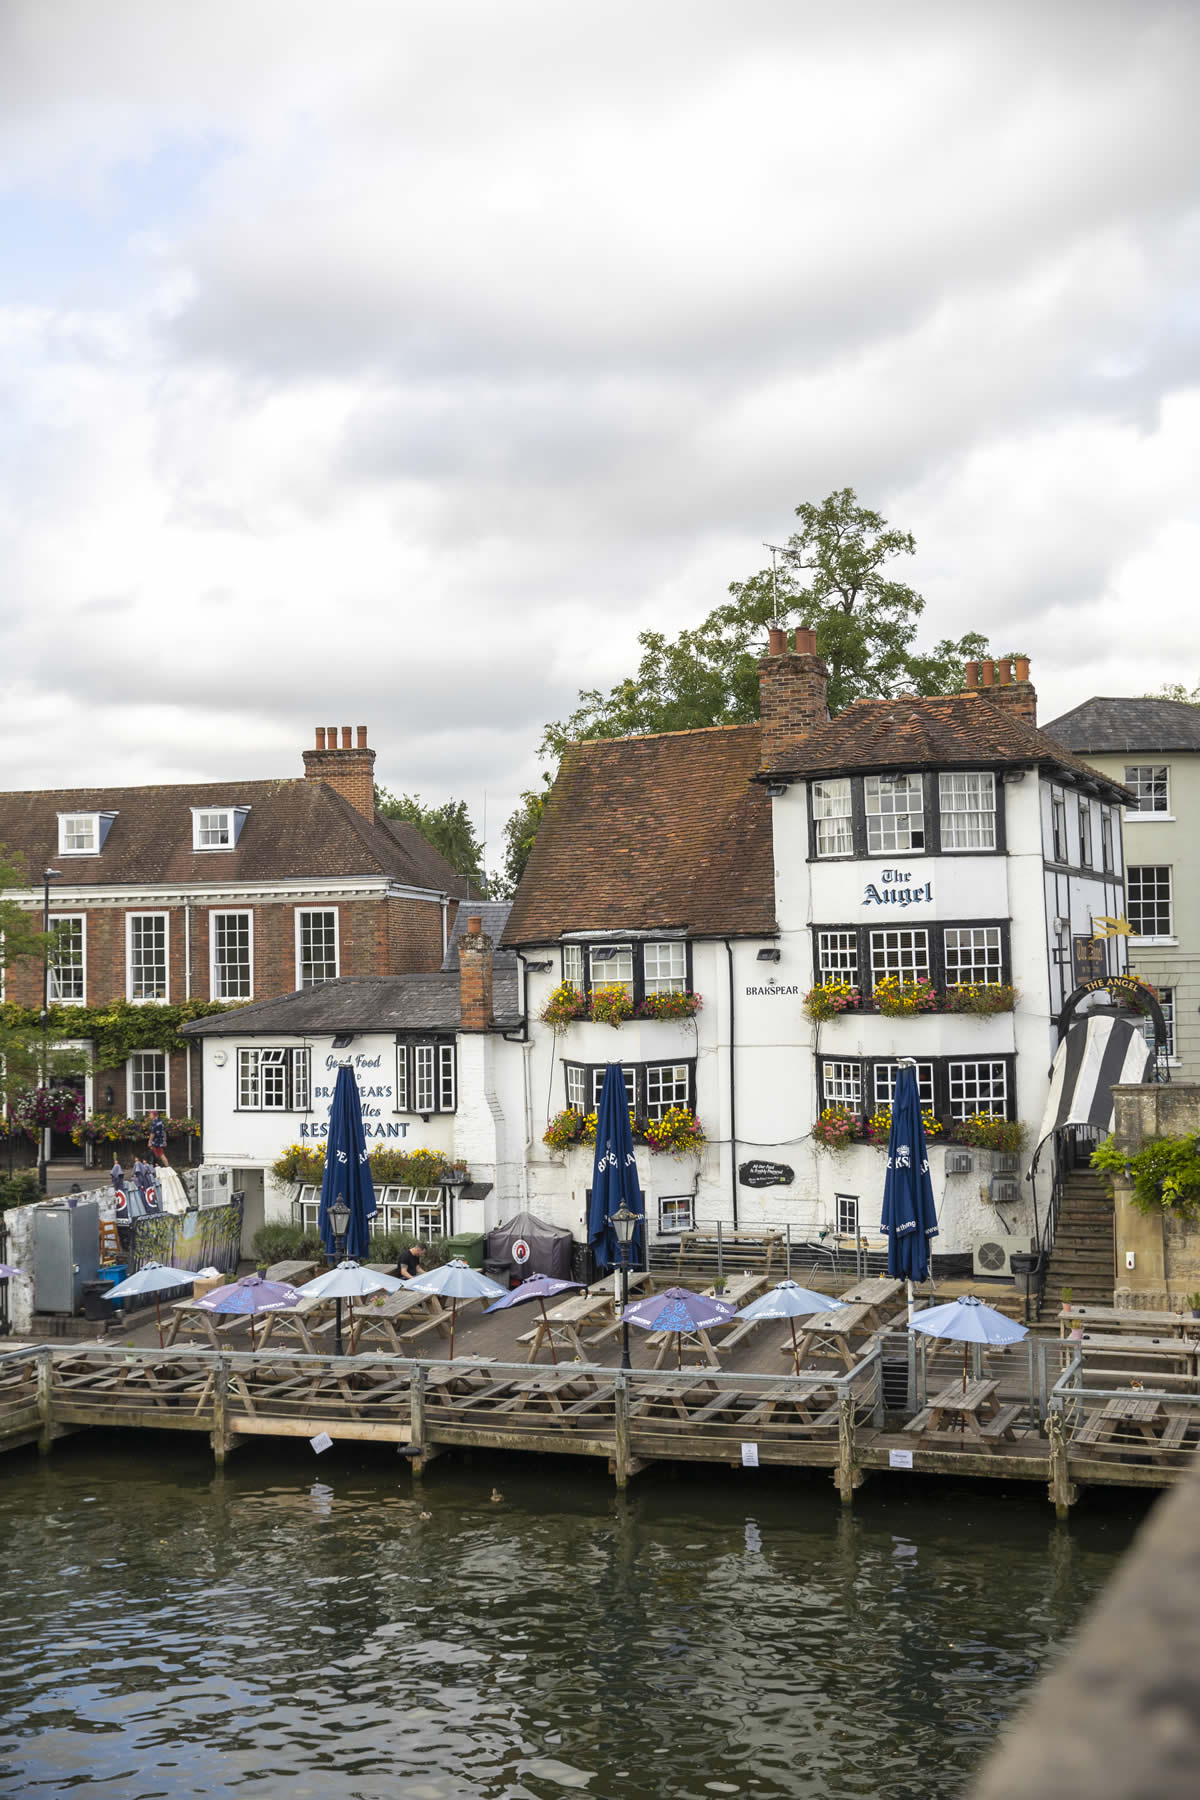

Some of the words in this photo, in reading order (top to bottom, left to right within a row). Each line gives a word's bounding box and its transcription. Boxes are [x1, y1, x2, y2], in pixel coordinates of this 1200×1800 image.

[881, 869, 912, 884] The
[861, 881, 934, 908] Angel
[745, 985, 799, 996] BRAKSPEAR
[1084, 978, 1104, 992] THE
[1106, 978, 1138, 993] ANGEL
[354, 1054, 382, 1069] Food
[299, 1122, 411, 1138] RESRANT
